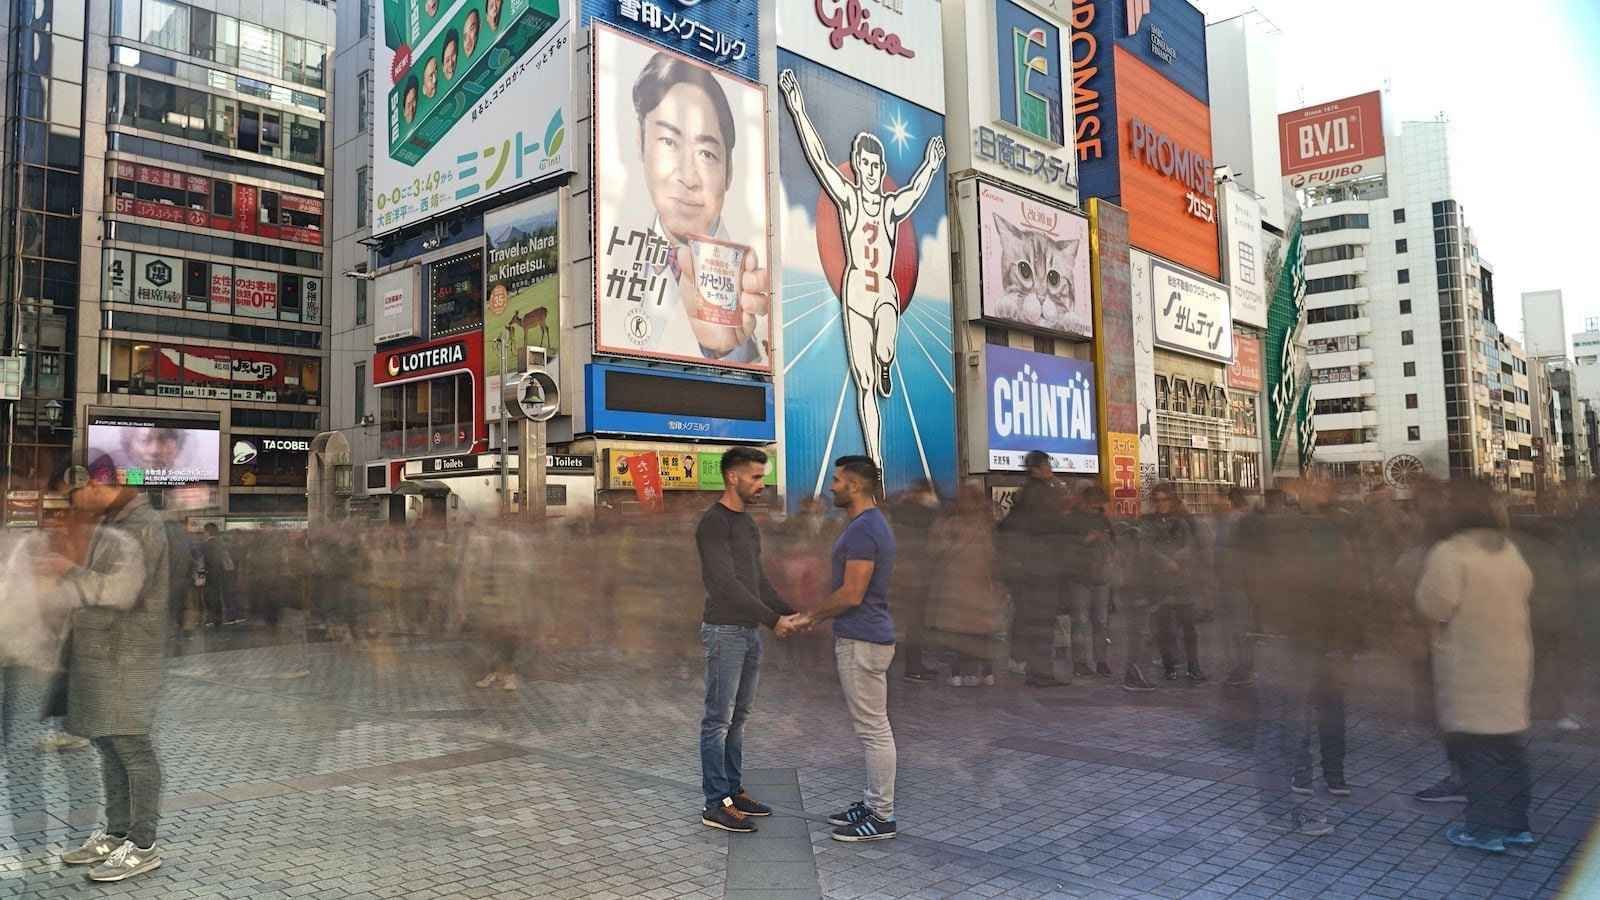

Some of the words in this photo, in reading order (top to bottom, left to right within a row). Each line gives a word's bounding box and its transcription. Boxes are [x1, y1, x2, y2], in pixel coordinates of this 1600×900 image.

[618, 0, 747, 62] 雪印メグミルク
[815, 0, 915, 59] Glico
[1299, 116, 1356, 160] B.V.D.
[1130, 116, 1214, 197] PROMISE
[1308, 164, 1363, 183] FUJIBO
[1185, 191, 1216, 224] プロミス
[489, 242, 520, 264] Travel
[520, 246, 529, 256] to
[529, 235, 555, 253] Nara
[606, 226, 669, 266] トクホ
[861, 219, 880, 294] グリコ
[489, 274, 498, 282] on
[499, 258, 546, 280] Kintetsu.
[632, 262, 643, 272] の
[606, 267, 668, 307] ガセリ
[402, 344, 463, 372] LOTTERIA
[669, 421, 711, 433] 雪印メグミルク
[443, 459, 464, 470] Toilets
[555, 456, 583, 468] Toilets
